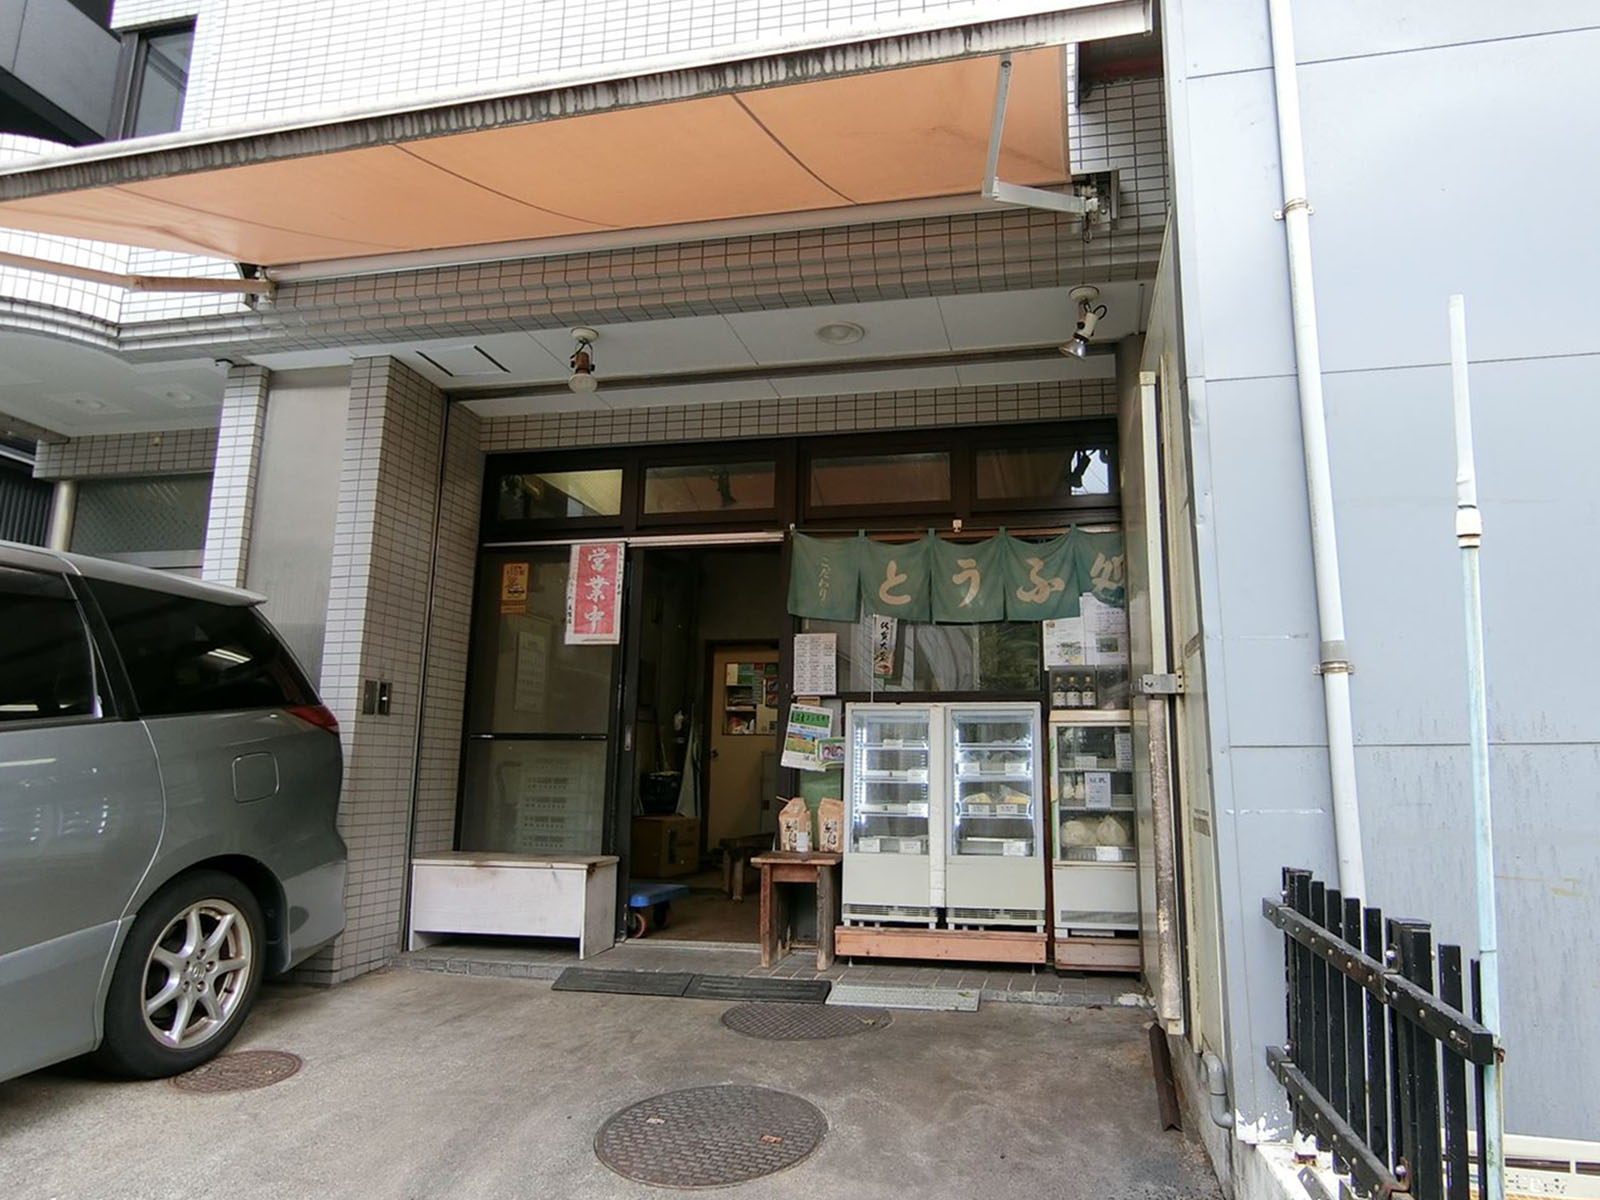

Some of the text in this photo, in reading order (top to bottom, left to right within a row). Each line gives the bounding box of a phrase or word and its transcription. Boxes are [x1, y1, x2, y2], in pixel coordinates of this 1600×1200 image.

[584, 546, 610, 633] 営業中
[878, 551, 1124, 607] とうふ処
